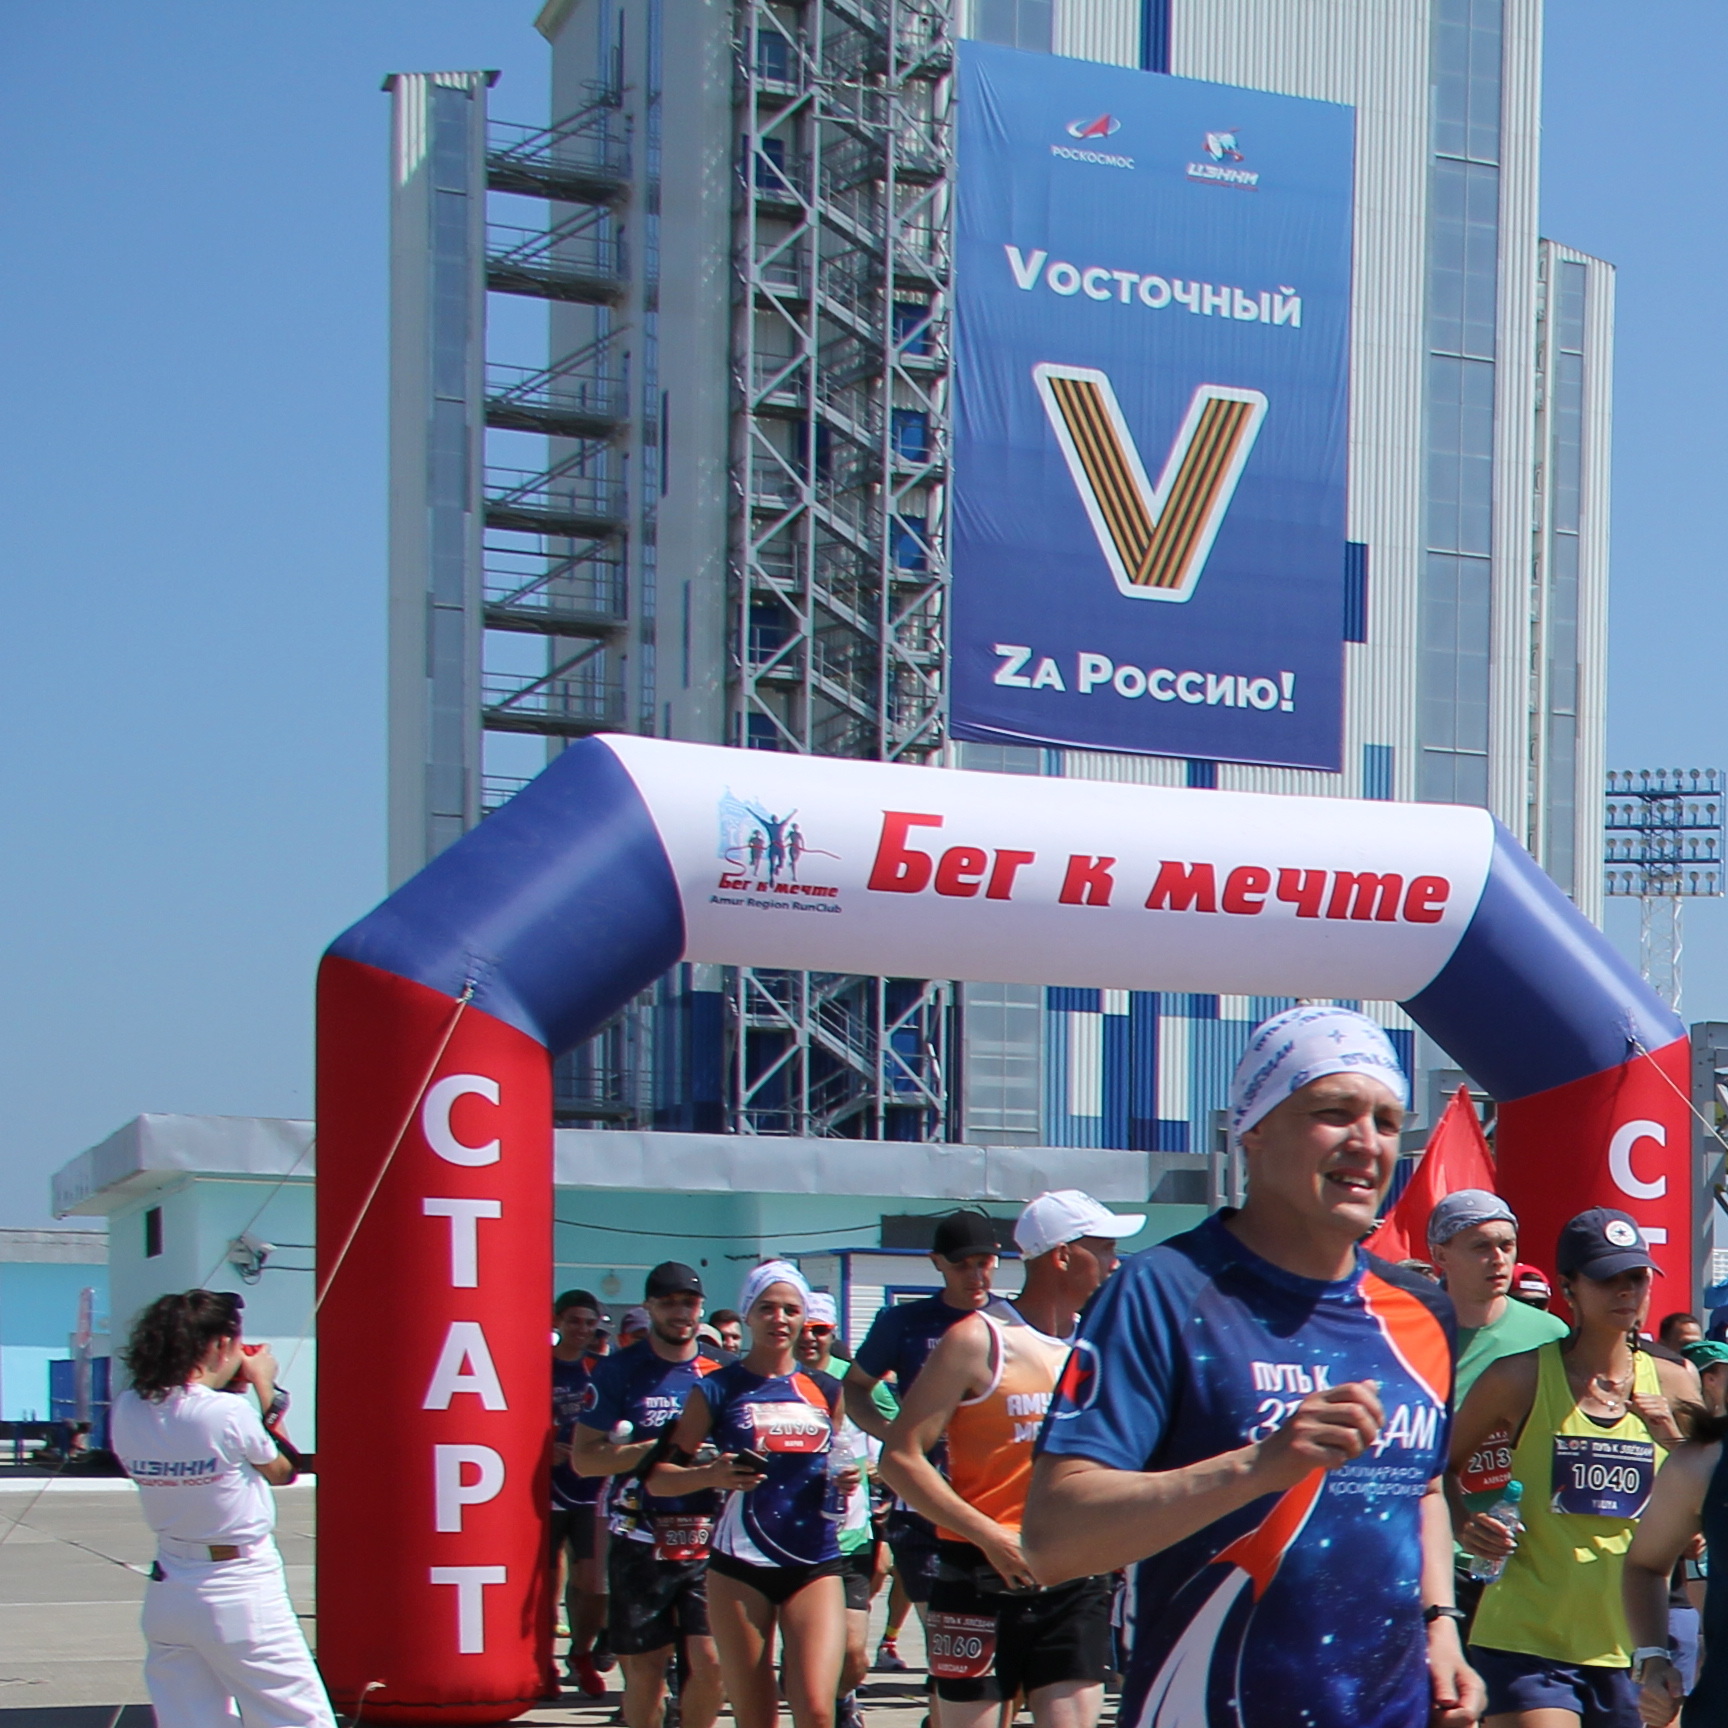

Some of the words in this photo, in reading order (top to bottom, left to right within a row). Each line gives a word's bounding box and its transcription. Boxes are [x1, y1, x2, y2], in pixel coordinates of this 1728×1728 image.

[1051, 145, 1135, 170] РОСКОСМОС
[866, 809, 1035, 899] Бег
[1144, 859, 1451, 925] мечте
[711, 895, 744, 906] Amur
[747, 898, 789, 911] Region
[774, 882, 839, 898] мечте
[422, 1074, 508, 1654] СТАРТ
[1252, 1362, 1313, 1394] ПУТЬ
[1571, 1463, 1641, 1494] 1040
[933, 1633, 982, 1659] 2160
